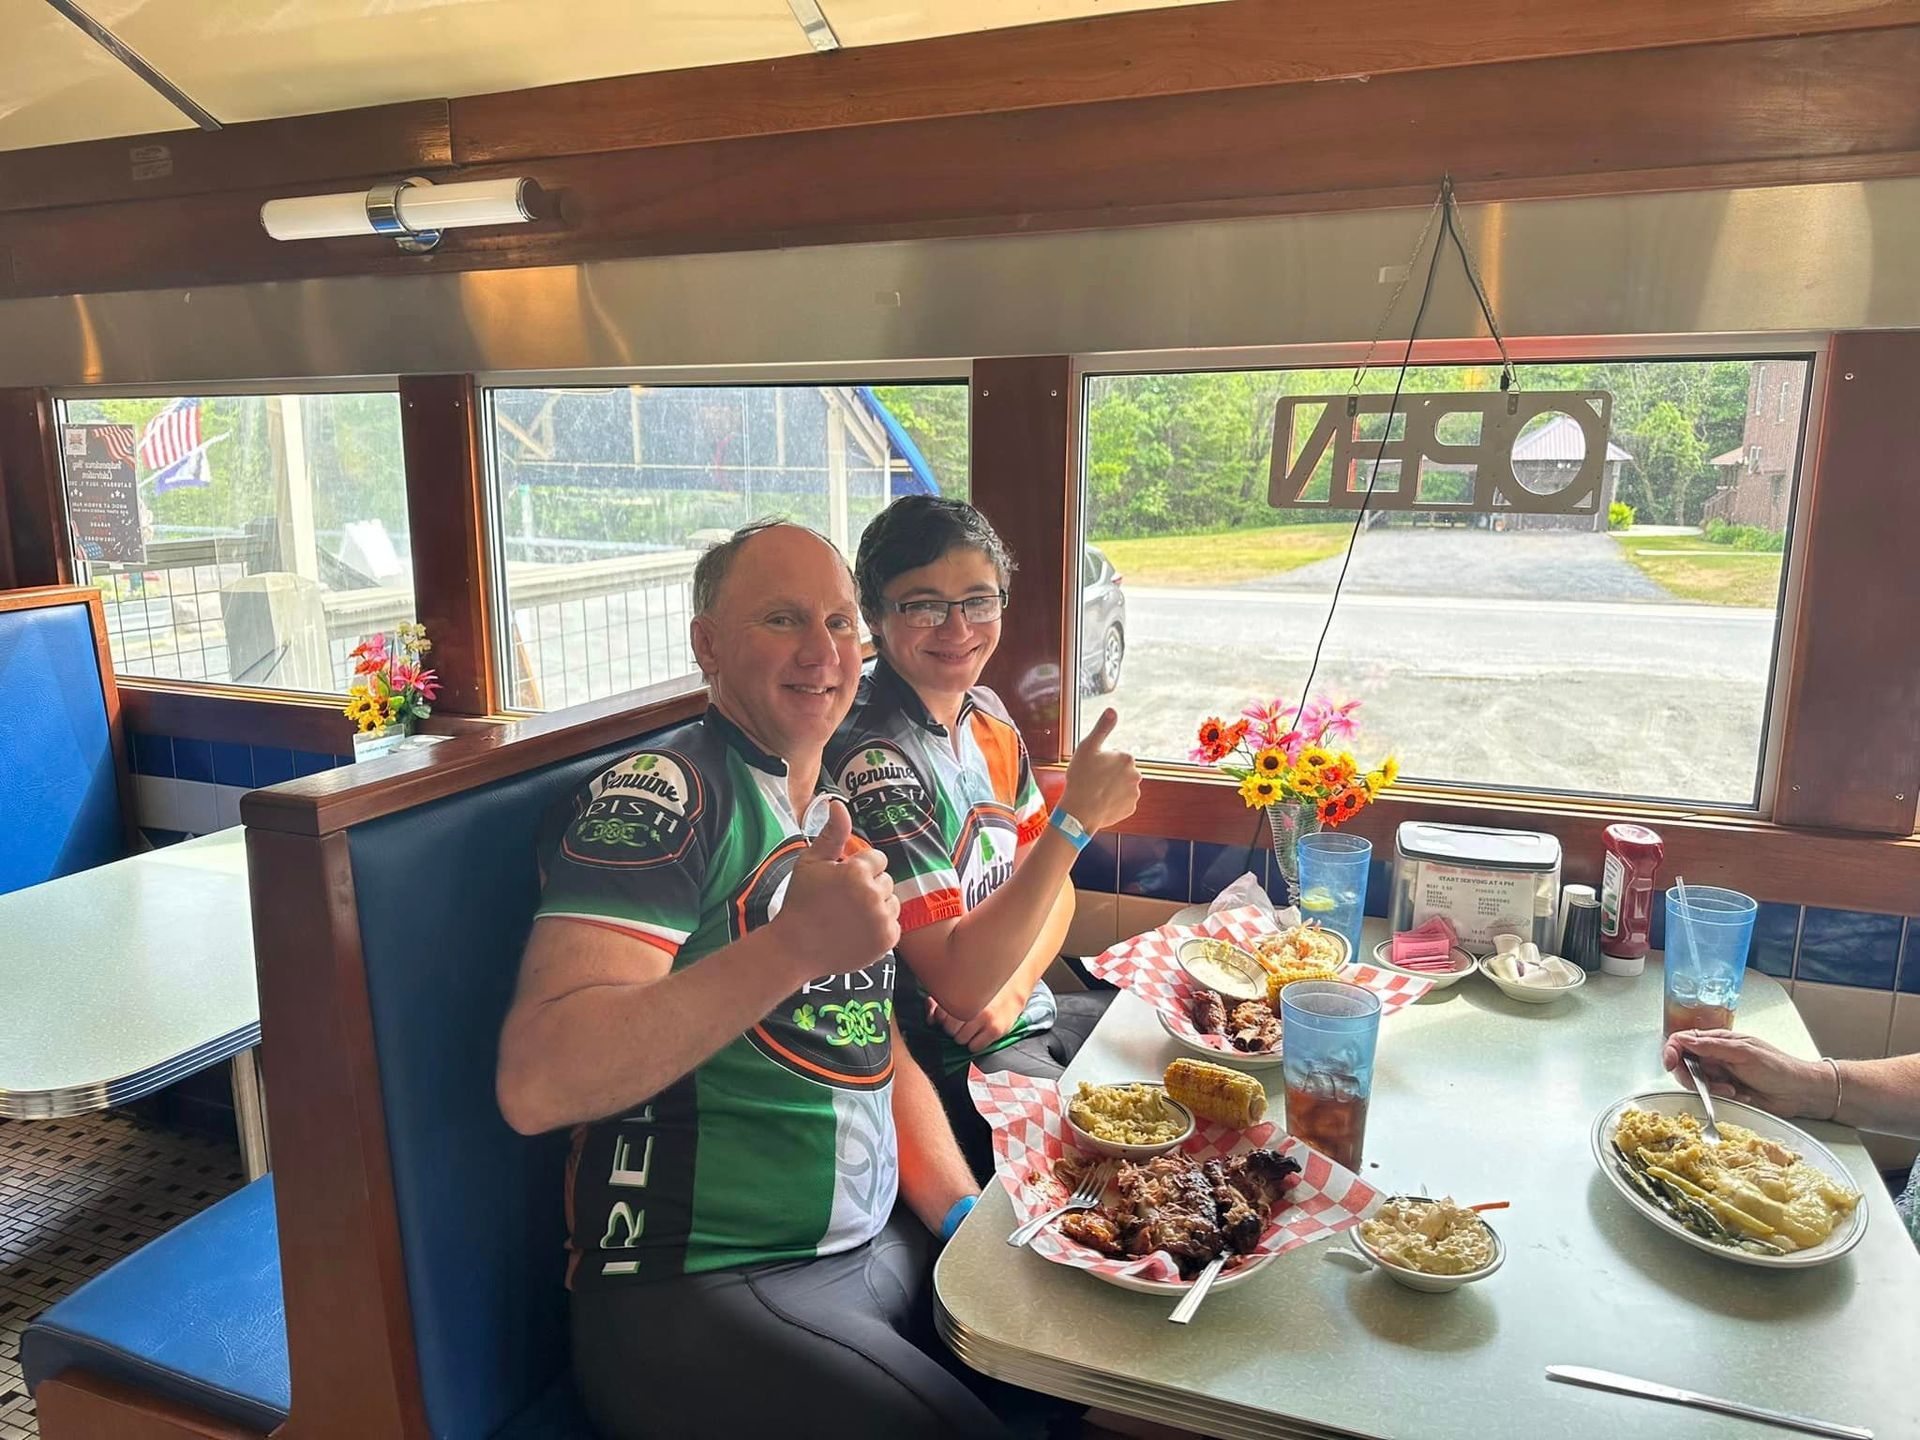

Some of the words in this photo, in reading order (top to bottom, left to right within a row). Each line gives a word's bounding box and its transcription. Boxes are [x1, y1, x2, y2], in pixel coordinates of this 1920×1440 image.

[598, 769, 680, 803] Genuine
[845, 762, 916, 797] Genuine
[852, 787, 925, 813] RISH
[1439, 876, 1459, 884] START
[801, 963, 896, 994] RISH
[600, 1104, 656, 1276] IREL
